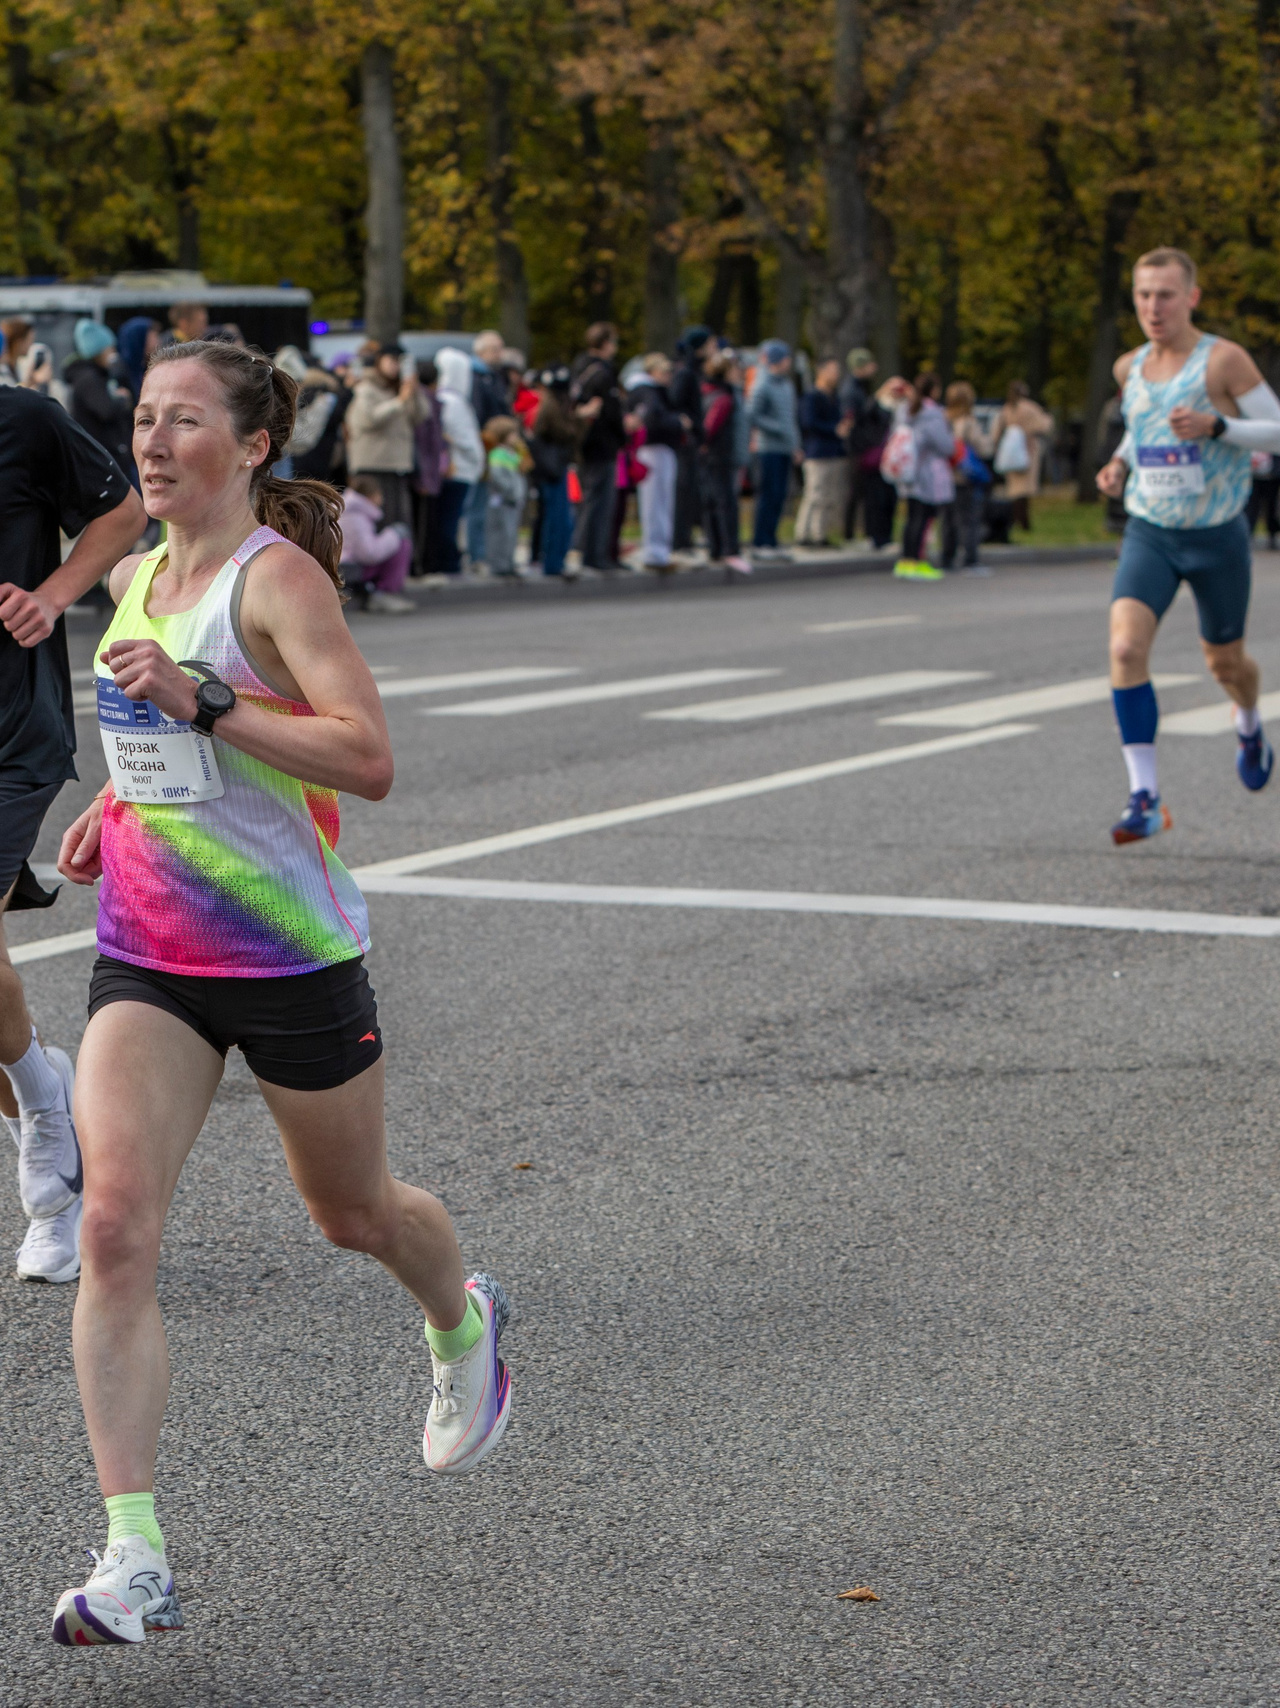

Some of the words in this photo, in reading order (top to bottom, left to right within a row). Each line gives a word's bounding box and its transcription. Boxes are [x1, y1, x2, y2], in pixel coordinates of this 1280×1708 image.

[116, 737, 160, 756] Бурзак
[117, 755, 167, 772] Оксана
[198, 749, 212, 781] МОСКВА
[131, 775, 152, 784] 16007
